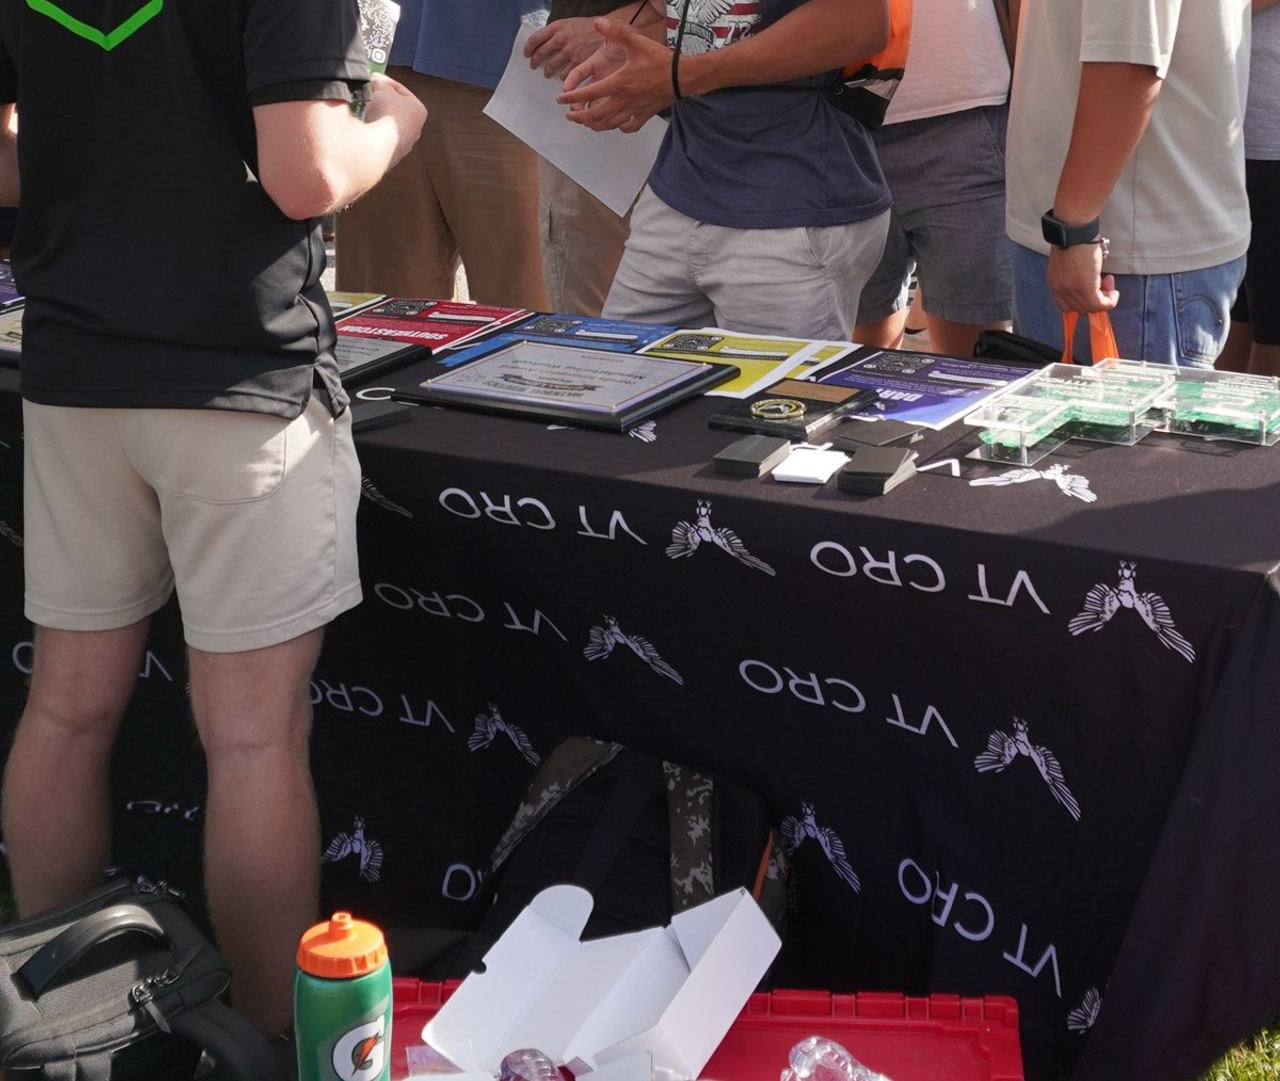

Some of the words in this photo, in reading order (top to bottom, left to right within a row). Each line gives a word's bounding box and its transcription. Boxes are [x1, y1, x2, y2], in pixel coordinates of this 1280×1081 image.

[438, 487, 556, 530] CRO
[577, 505, 648, 546] VT
[810, 541, 946, 593] CRO
[968, 564, 1051, 614] VT
[374, 583, 486, 623] CRO
[504, 602, 569, 642] VT
[739, 659, 866, 713] CRO
[400, 694, 456, 734] VT
[886, 693, 959, 749] VT
[1002, 924, 1062, 998] VT
